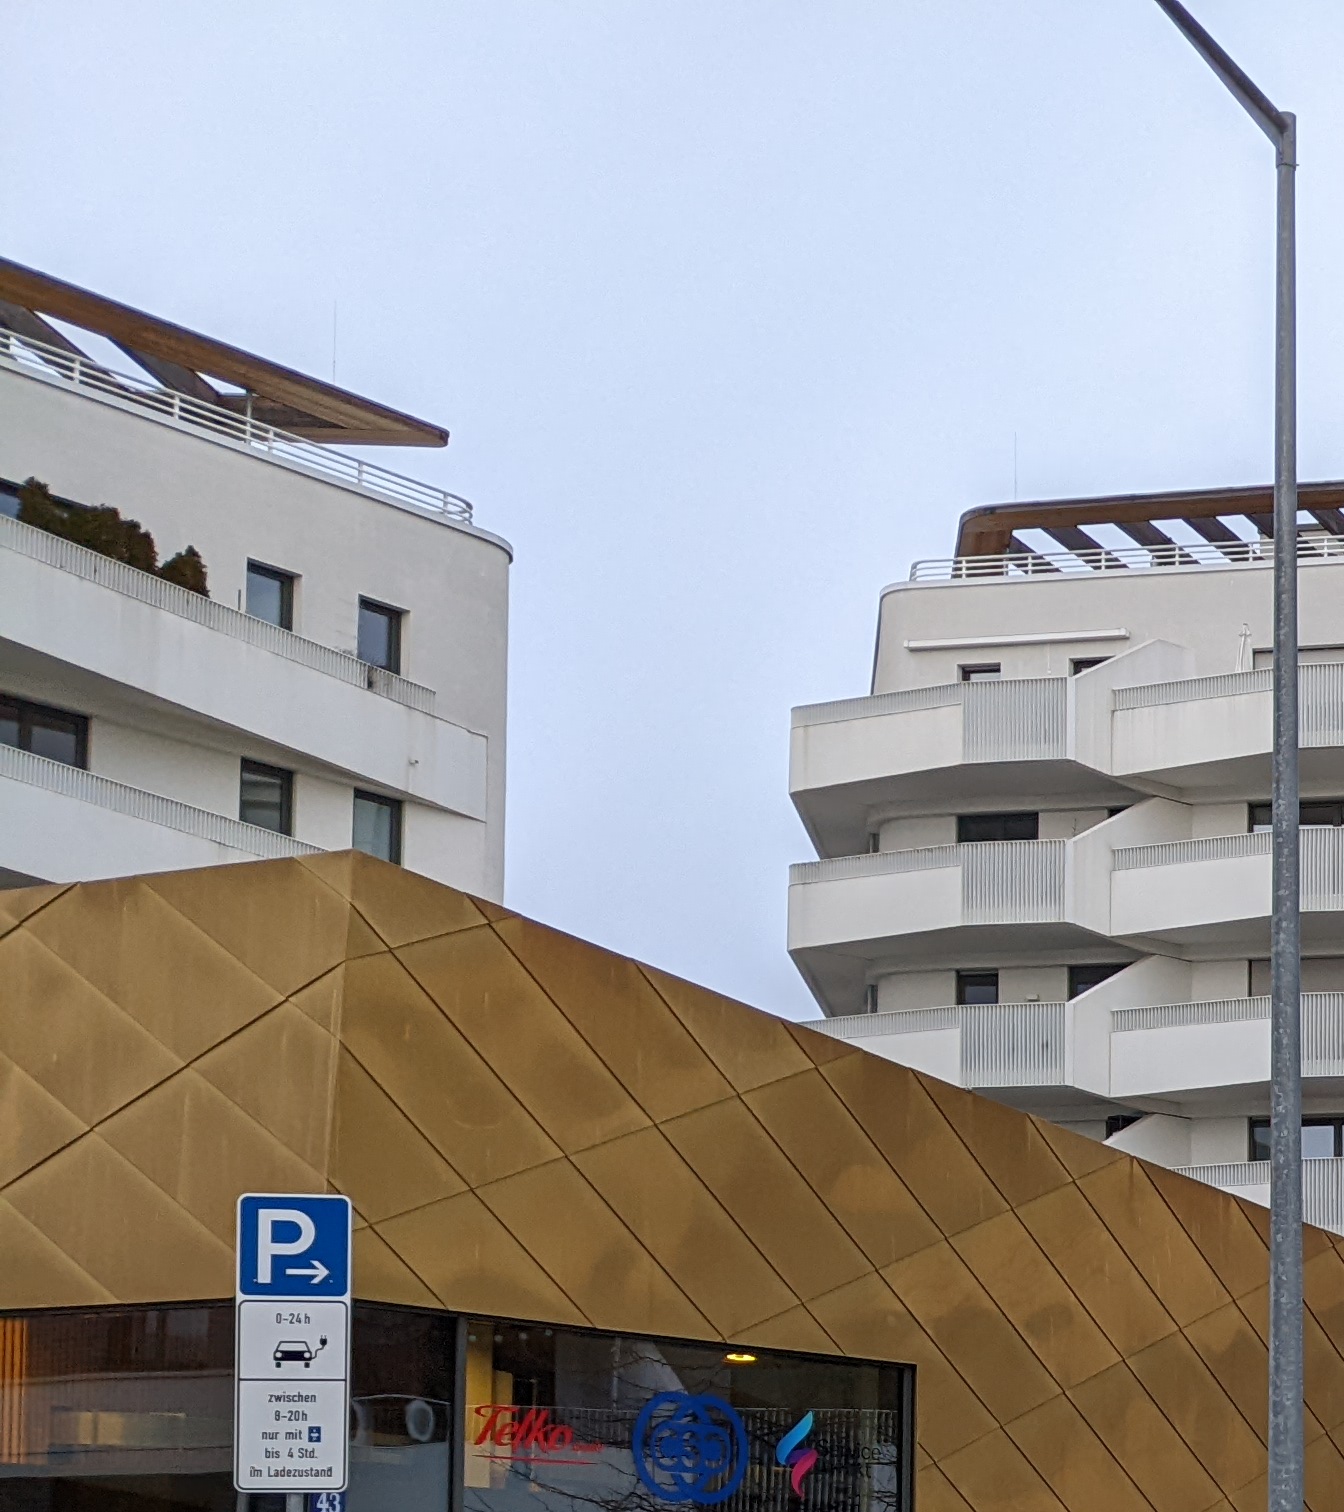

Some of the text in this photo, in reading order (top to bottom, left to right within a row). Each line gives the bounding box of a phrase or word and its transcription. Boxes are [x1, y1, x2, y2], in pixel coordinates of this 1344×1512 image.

[257, 1209, 316, 1284] P
[267, 1391, 317, 1403] zwischen
[261, 1428, 303, 1440] nur mit
[474, 1405, 574, 1454] Telko
[264, 1447, 318, 1460] bis 4 Std.
[249, 1466, 333, 1478] im Ladezustand
